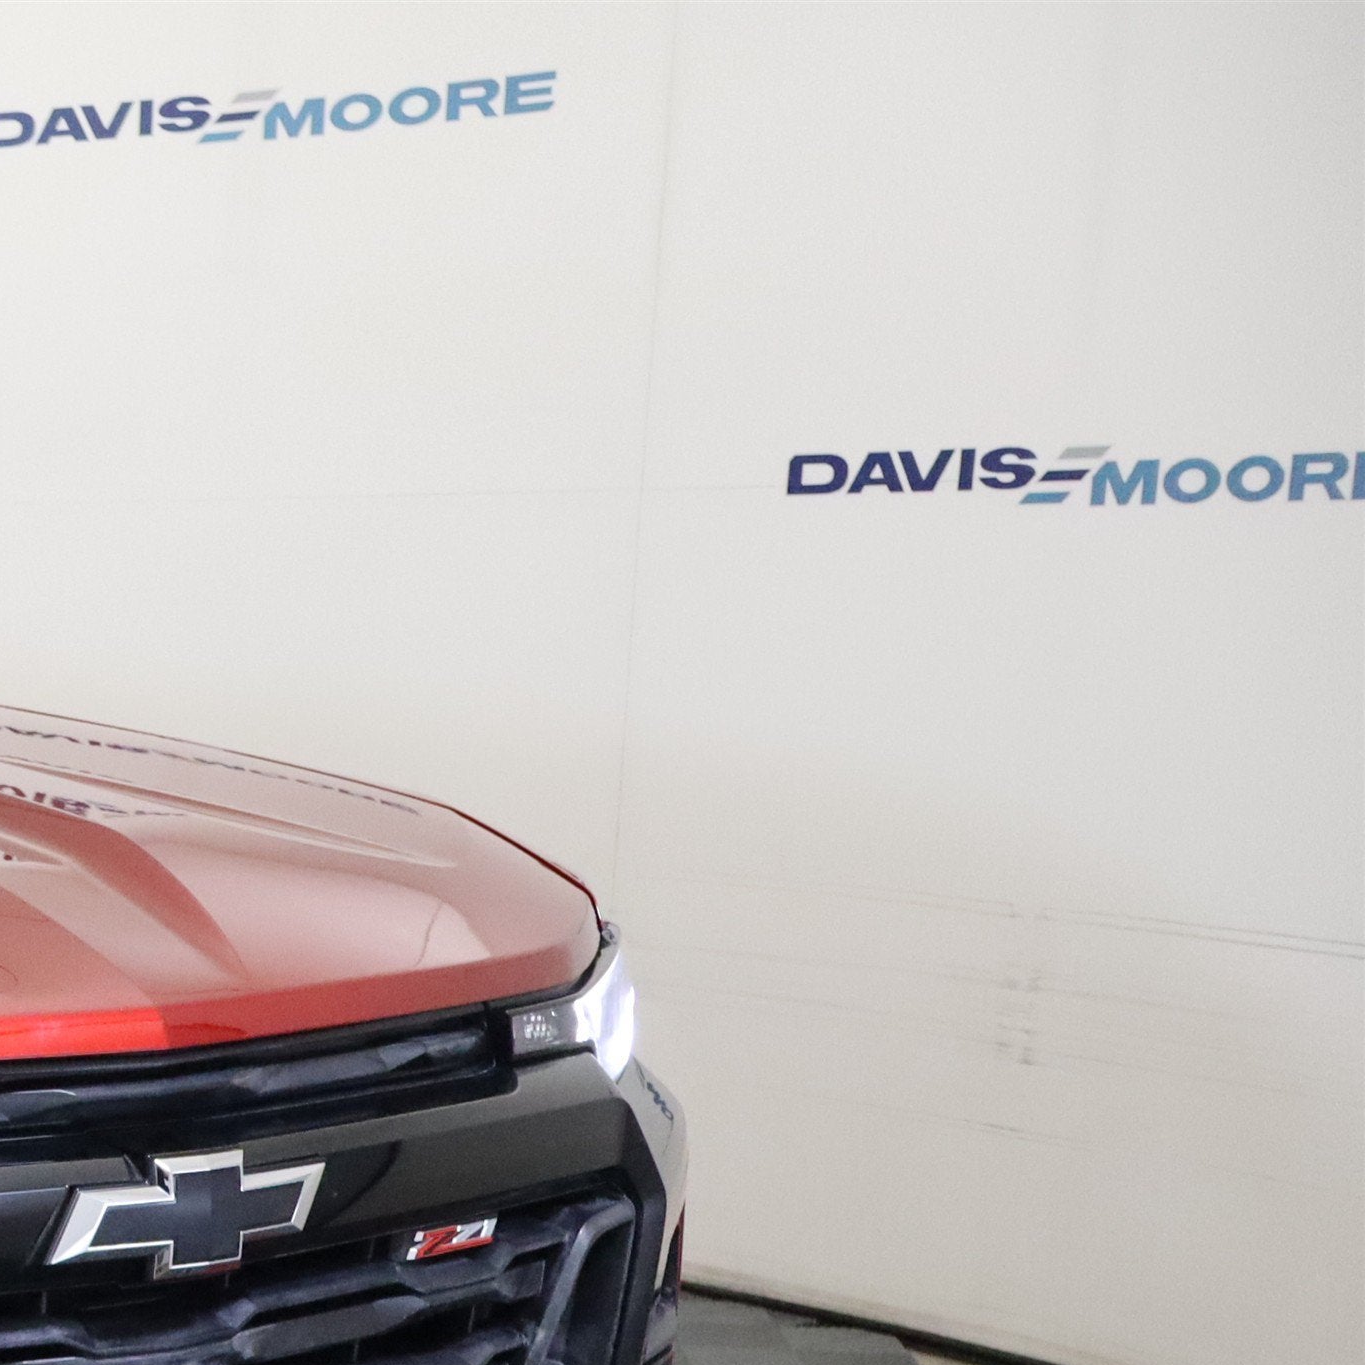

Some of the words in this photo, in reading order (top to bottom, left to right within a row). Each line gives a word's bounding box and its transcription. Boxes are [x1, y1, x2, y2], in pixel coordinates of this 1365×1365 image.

[263, 70, 557, 141] MOORE
[786, 446, 1038, 495] DAVIS
[1089, 451, 1365, 506] MOOR
[406, 1217, 498, 1261] Z71
